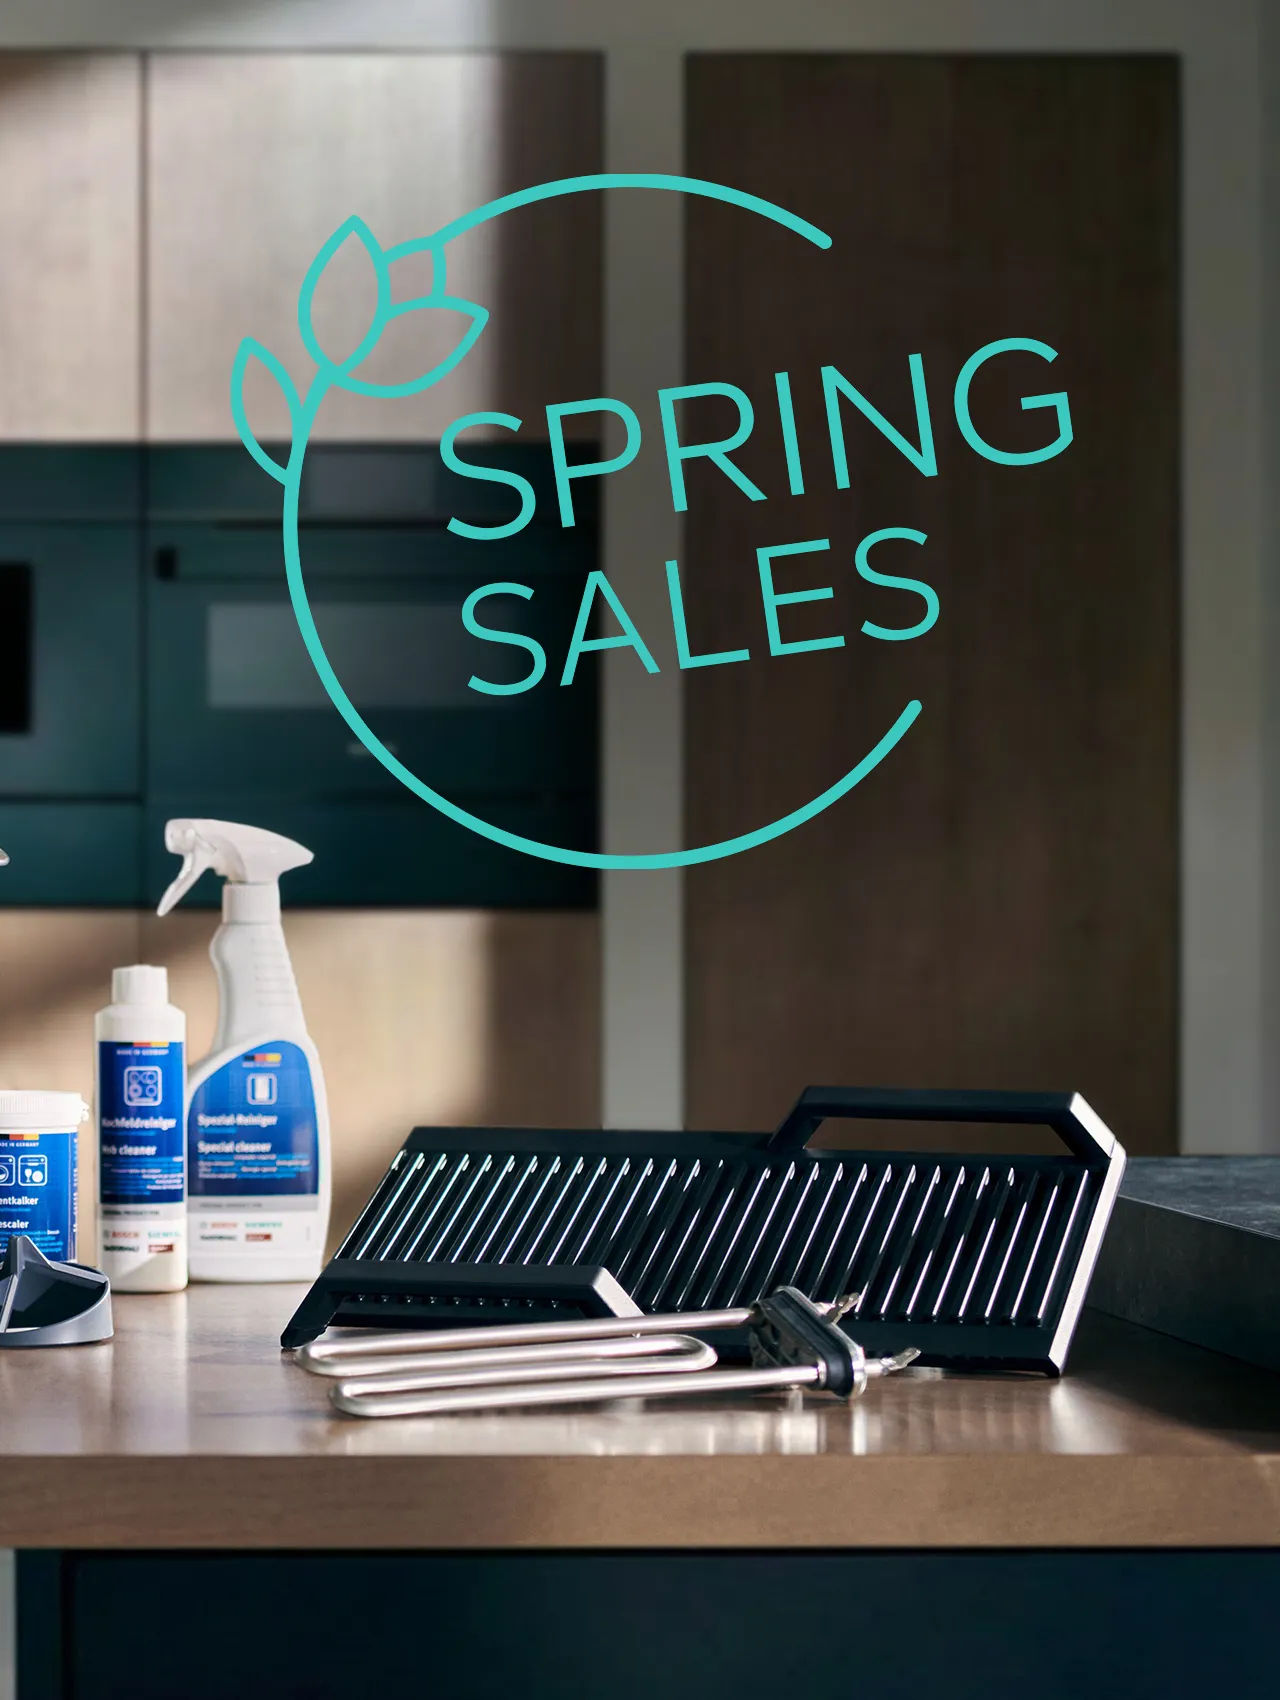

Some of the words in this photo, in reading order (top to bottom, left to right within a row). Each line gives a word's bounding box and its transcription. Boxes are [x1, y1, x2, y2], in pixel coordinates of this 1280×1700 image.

[119, 1144, 157, 1156] cleaner
[197, 1141, 235, 1155] Special
[235, 1141, 272, 1153] cleaner
